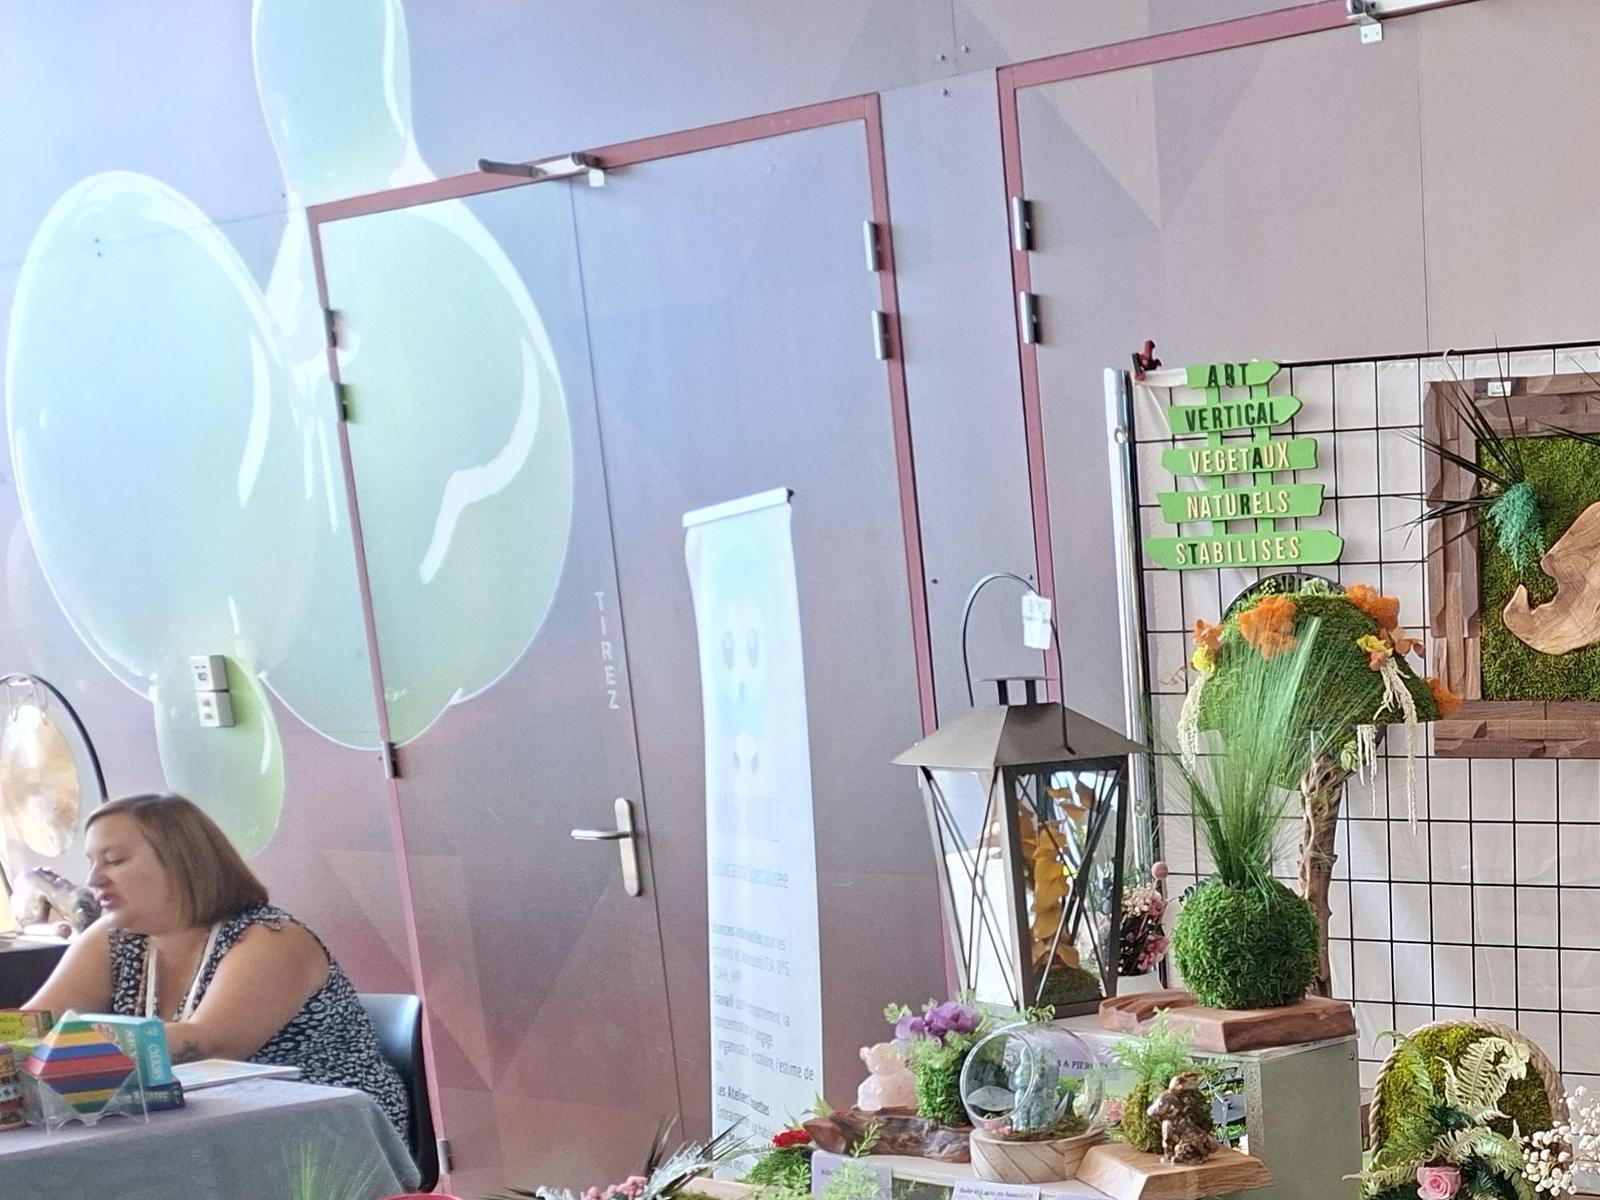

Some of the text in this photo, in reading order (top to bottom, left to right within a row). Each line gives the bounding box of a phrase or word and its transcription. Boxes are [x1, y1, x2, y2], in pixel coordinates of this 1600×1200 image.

[1207, 363, 1249, 388] ART
[1185, 402, 1280, 432] VERTICAL
[1189, 441, 1290, 474] VEGETAUX
[1187, 490, 1290, 519] NATURELS
[1176, 537, 1302, 566] STABILISES
[594, 591, 619, 709] TIREZ
